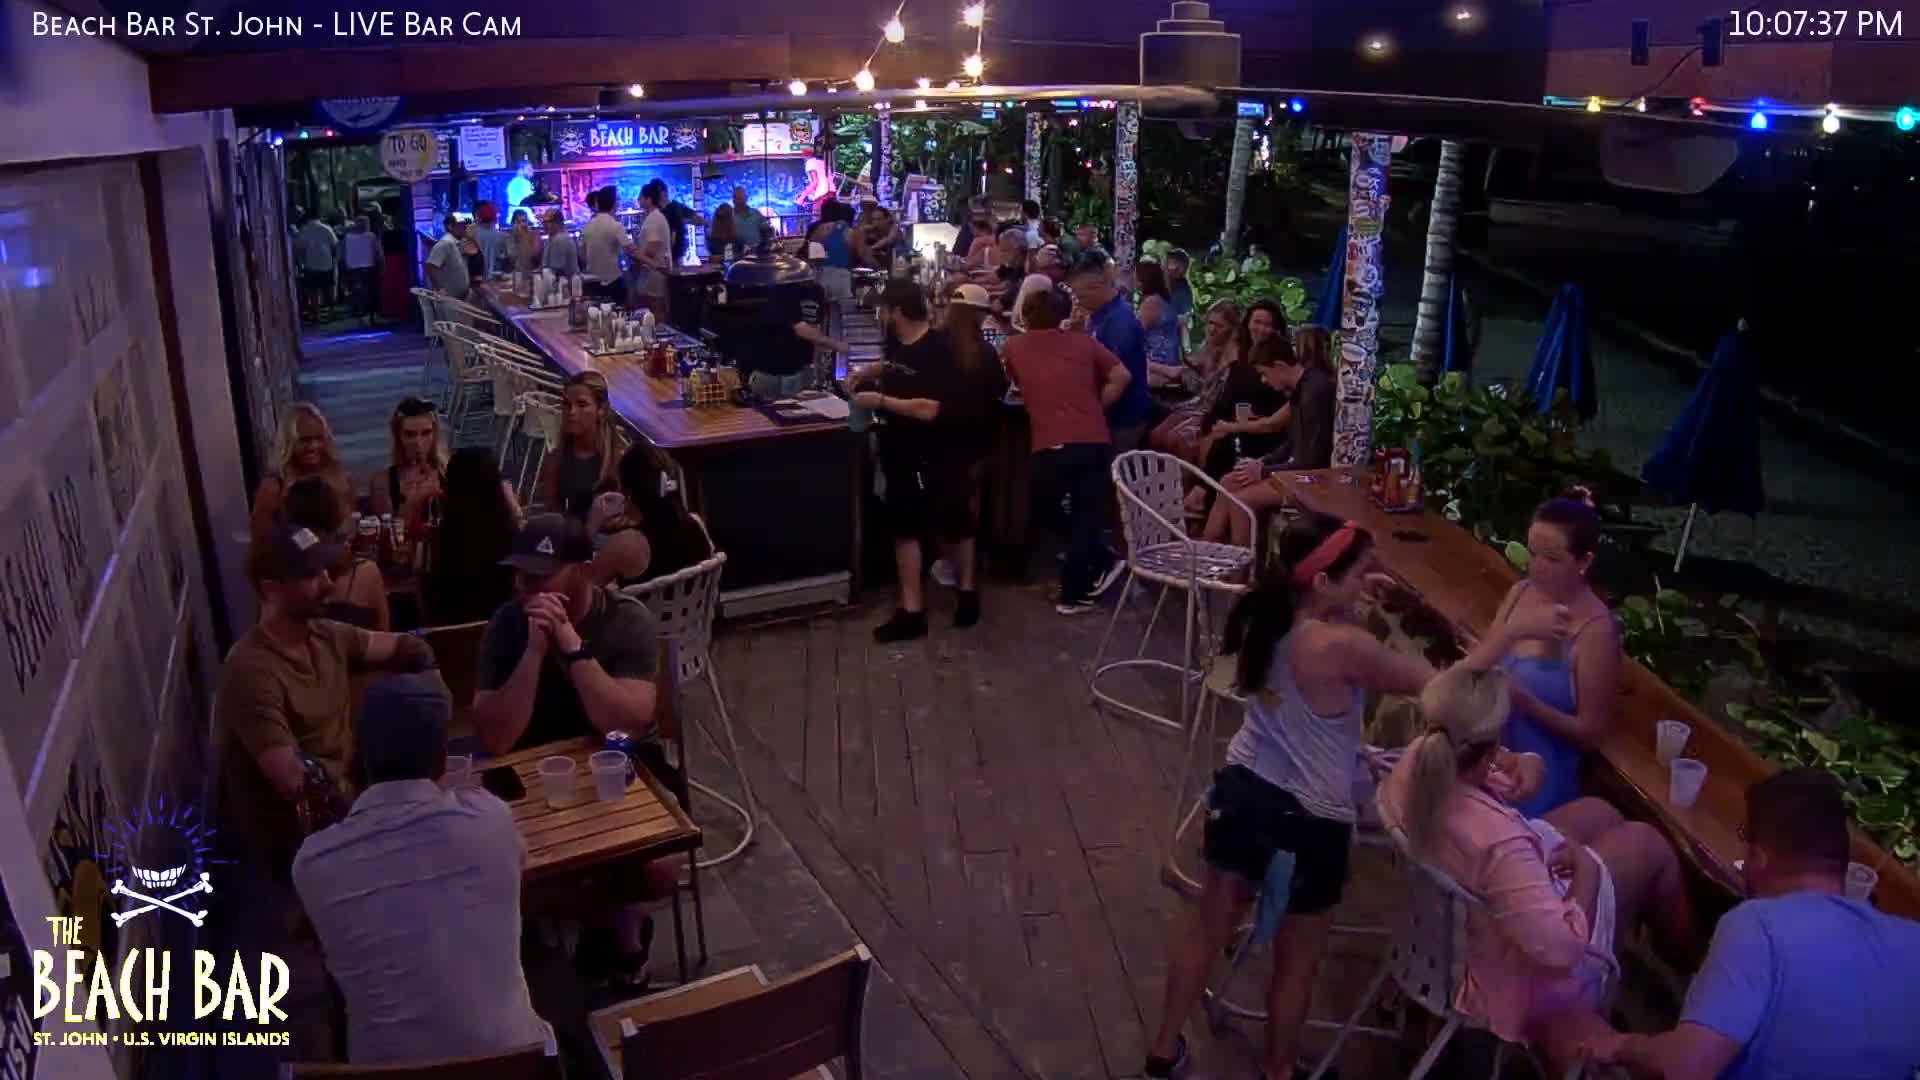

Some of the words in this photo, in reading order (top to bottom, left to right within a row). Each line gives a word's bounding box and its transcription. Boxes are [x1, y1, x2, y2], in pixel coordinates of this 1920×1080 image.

[389, 135, 405, 154] TO
[410, 133, 427, 153] GO
[590, 126, 634, 148] BEACH
[639, 125, 670, 146] BAR
